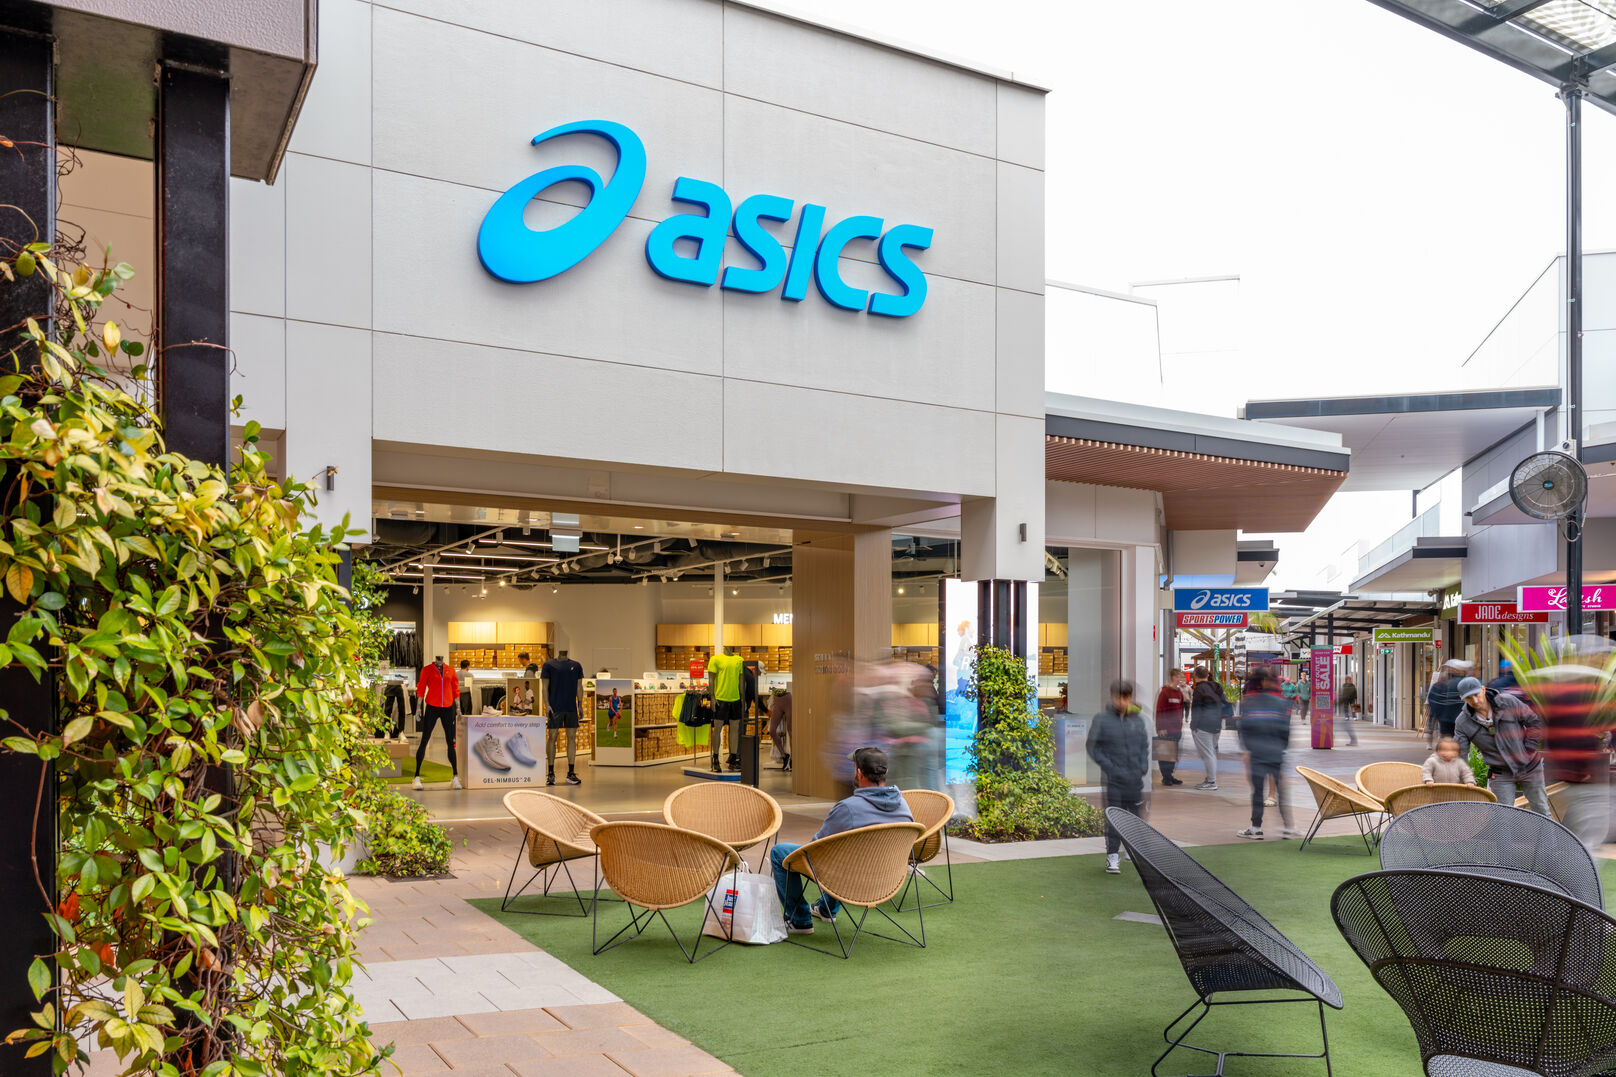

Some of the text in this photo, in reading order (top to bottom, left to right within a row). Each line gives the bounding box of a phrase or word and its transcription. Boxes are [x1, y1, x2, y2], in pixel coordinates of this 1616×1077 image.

[1183, 615, 1242, 624] SPORTSPOWER
[1475, 605, 1534, 621] JADE designs
[1320, 656, 1330, 689] SALE
